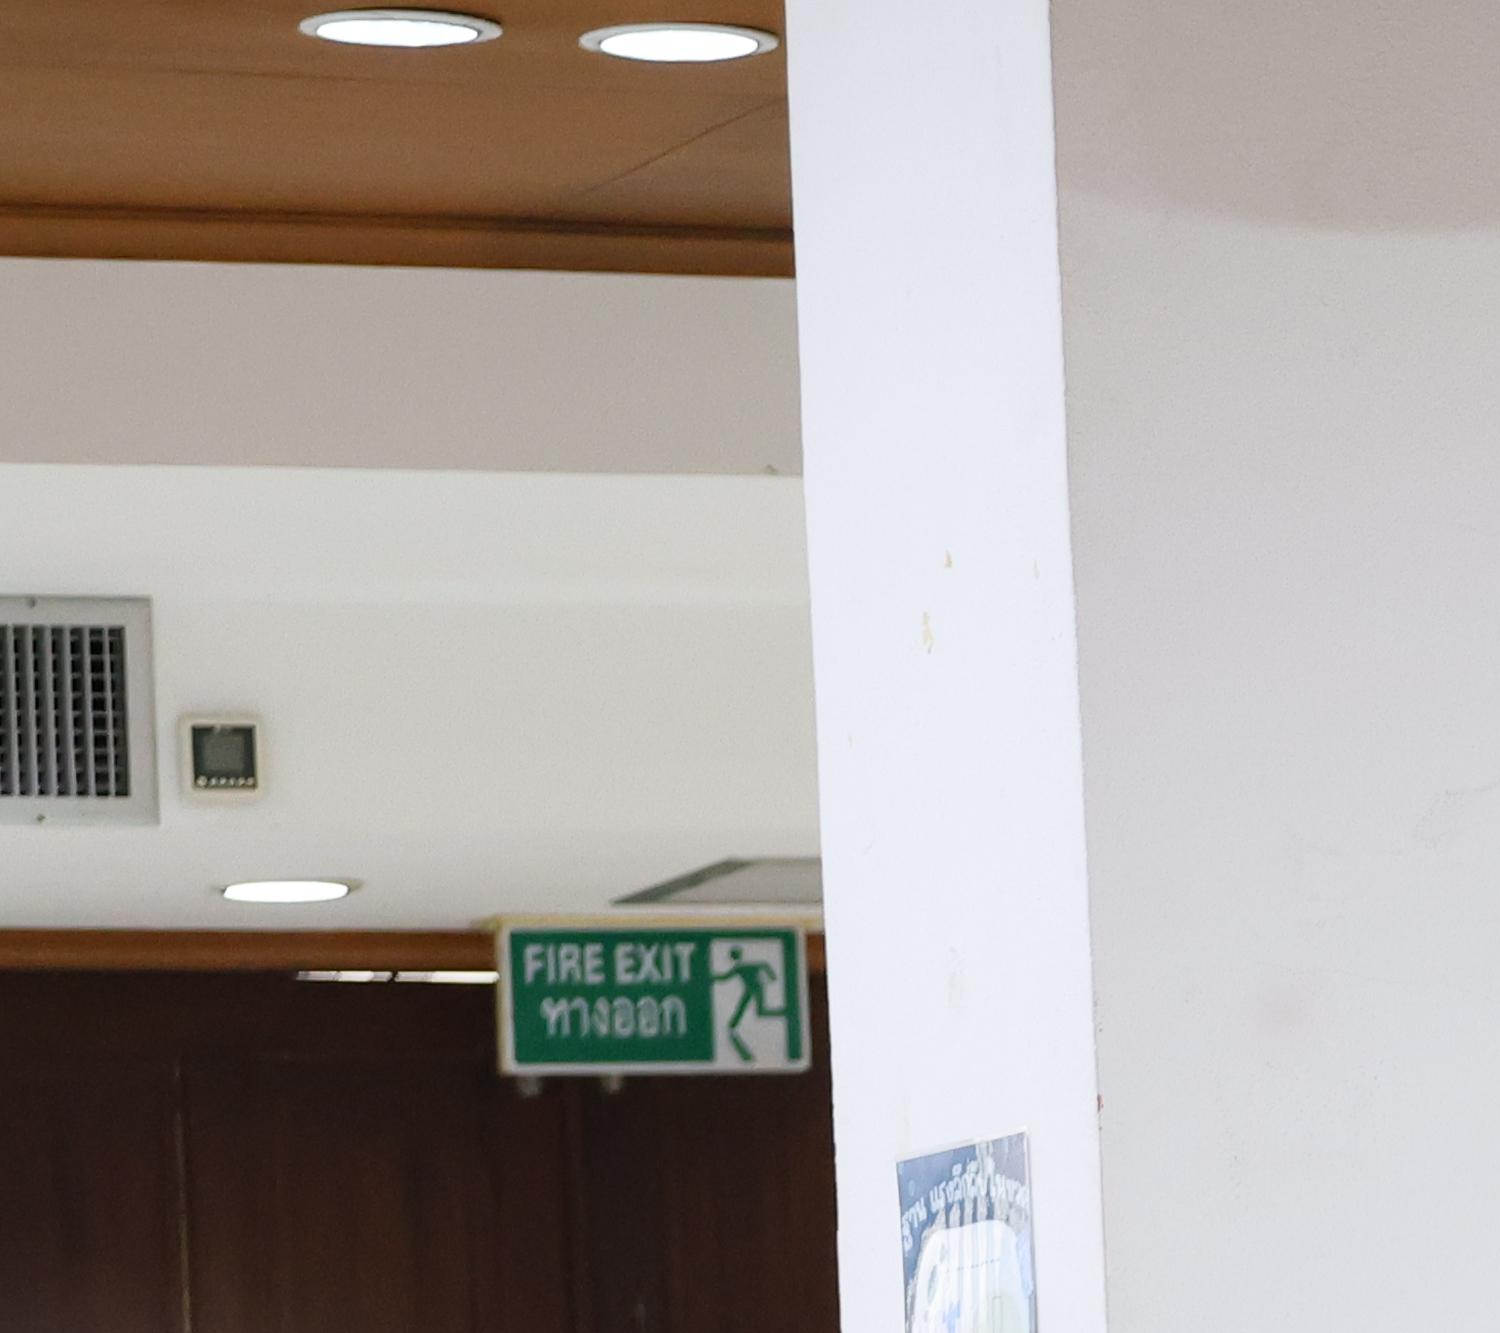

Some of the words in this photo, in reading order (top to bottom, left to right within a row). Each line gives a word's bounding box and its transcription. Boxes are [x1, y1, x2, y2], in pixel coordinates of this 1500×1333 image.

[523, 942, 606, 985] FIRE
[614, 942, 697, 986] EXIT
[539, 994, 688, 1039] ทางออก
